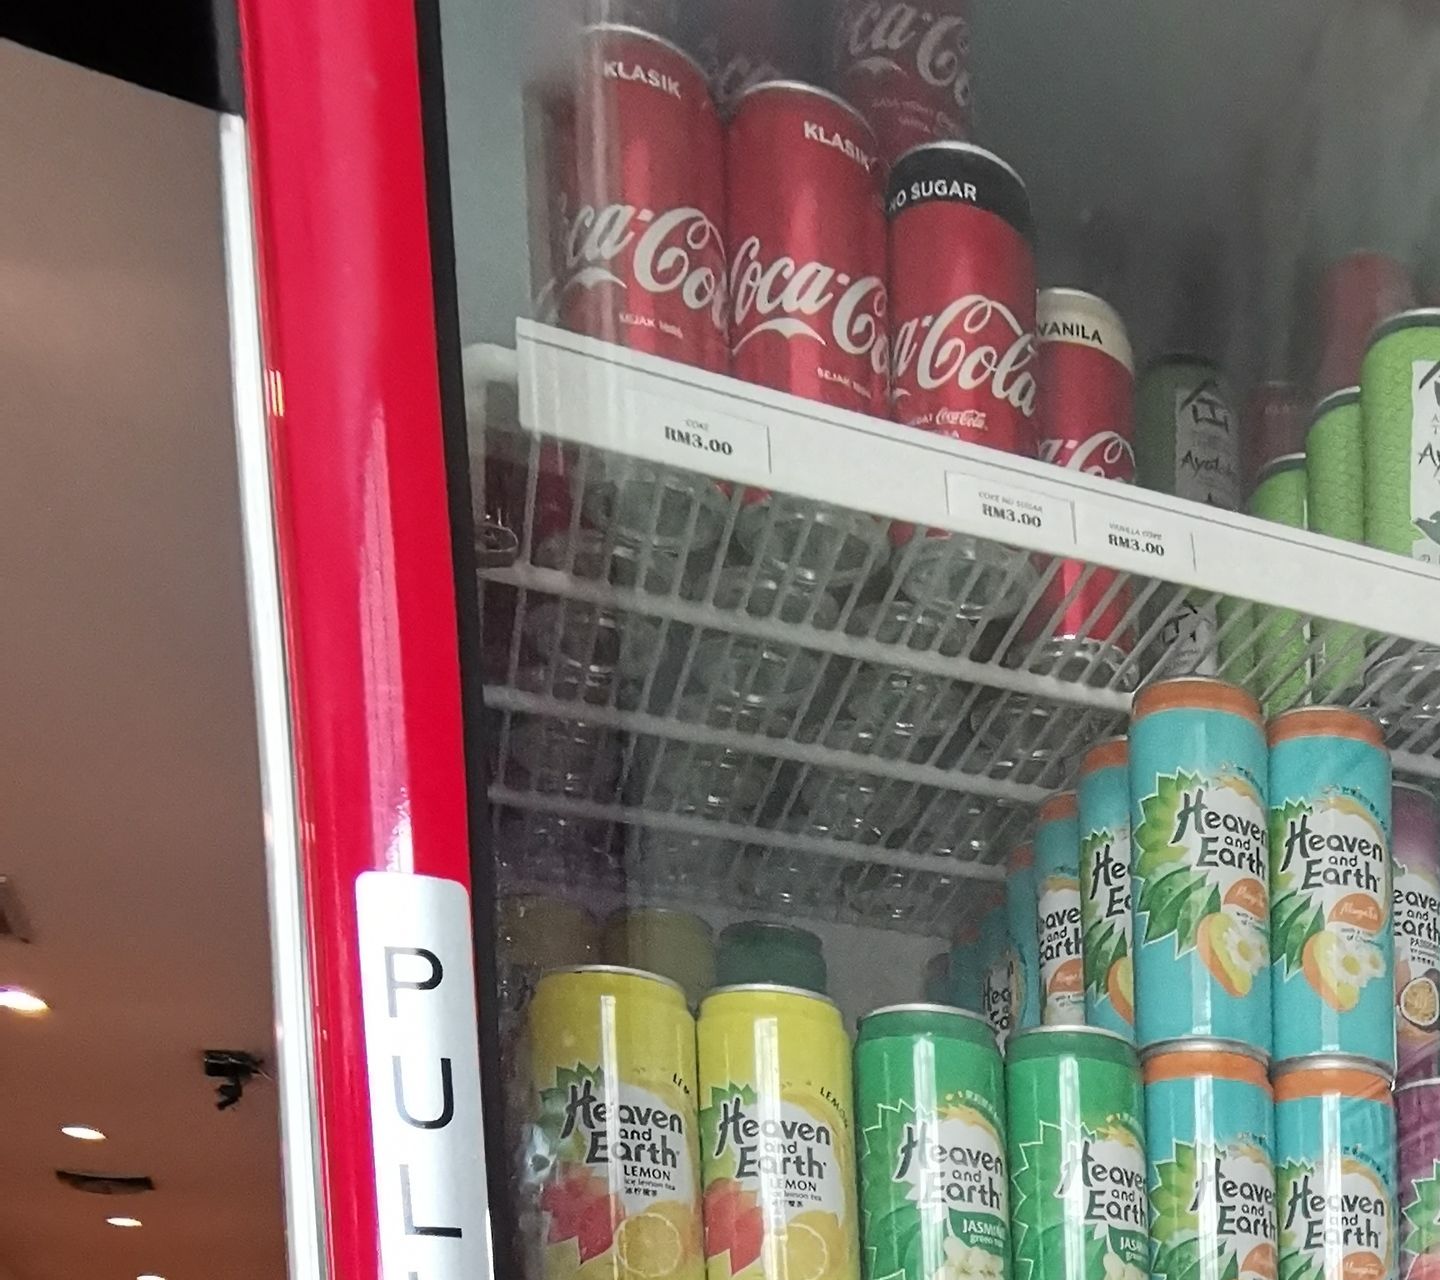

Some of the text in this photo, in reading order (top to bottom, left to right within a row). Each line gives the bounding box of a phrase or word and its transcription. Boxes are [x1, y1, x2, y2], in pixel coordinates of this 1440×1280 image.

[603, 60, 681, 100] KLASIK
[803, 120, 872, 171] KLASIK
[911, 179, 977, 202] SUGAR
[1038, 321, 1102, 345] VANILA
[664, 425, 734, 456] RM3.00
[981, 503, 1042, 528] RM3.00
[1108, 533, 1165, 557] RM3.00
[1171, 788, 1266, 845] Heaven
[1224, 835, 1251, 850] and
[1281, 814, 1383, 872] Heaven
[1199, 836, 1265, 880] Earth
[1328, 853, 1358, 868] and
[1302, 858, 1380, 893] Earth
[1407, 909, 1428, 921] and
[1046, 926, 1067, 943] and
[560, 1079, 683, 1139] Heaven
[618, 1127, 652, 1142] and
[713, 1097, 831, 1159] Heaven
[585, 1130, 679, 1169] Earth
[764, 1140, 798, 1155] and
[895, 1124, 1004, 1181] Heaven
[623, 1164, 671, 1182] LEMON
[734, 1145, 826, 1180] Earth
[952, 1169, 982, 1182] and
[769, 1177, 818, 1193] LEMON
[924, 1171, 1002, 1210] Earth
[1111, 1189, 1136, 1202] and
[1086, 1190, 1149, 1227] Earth
[1241, 1204, 1265, 1217] and
[1285, 1176, 1385, 1230] Heaven
[1303, 1219, 1381, 1249] Earth
[1330, 1214, 1358, 1227] and
